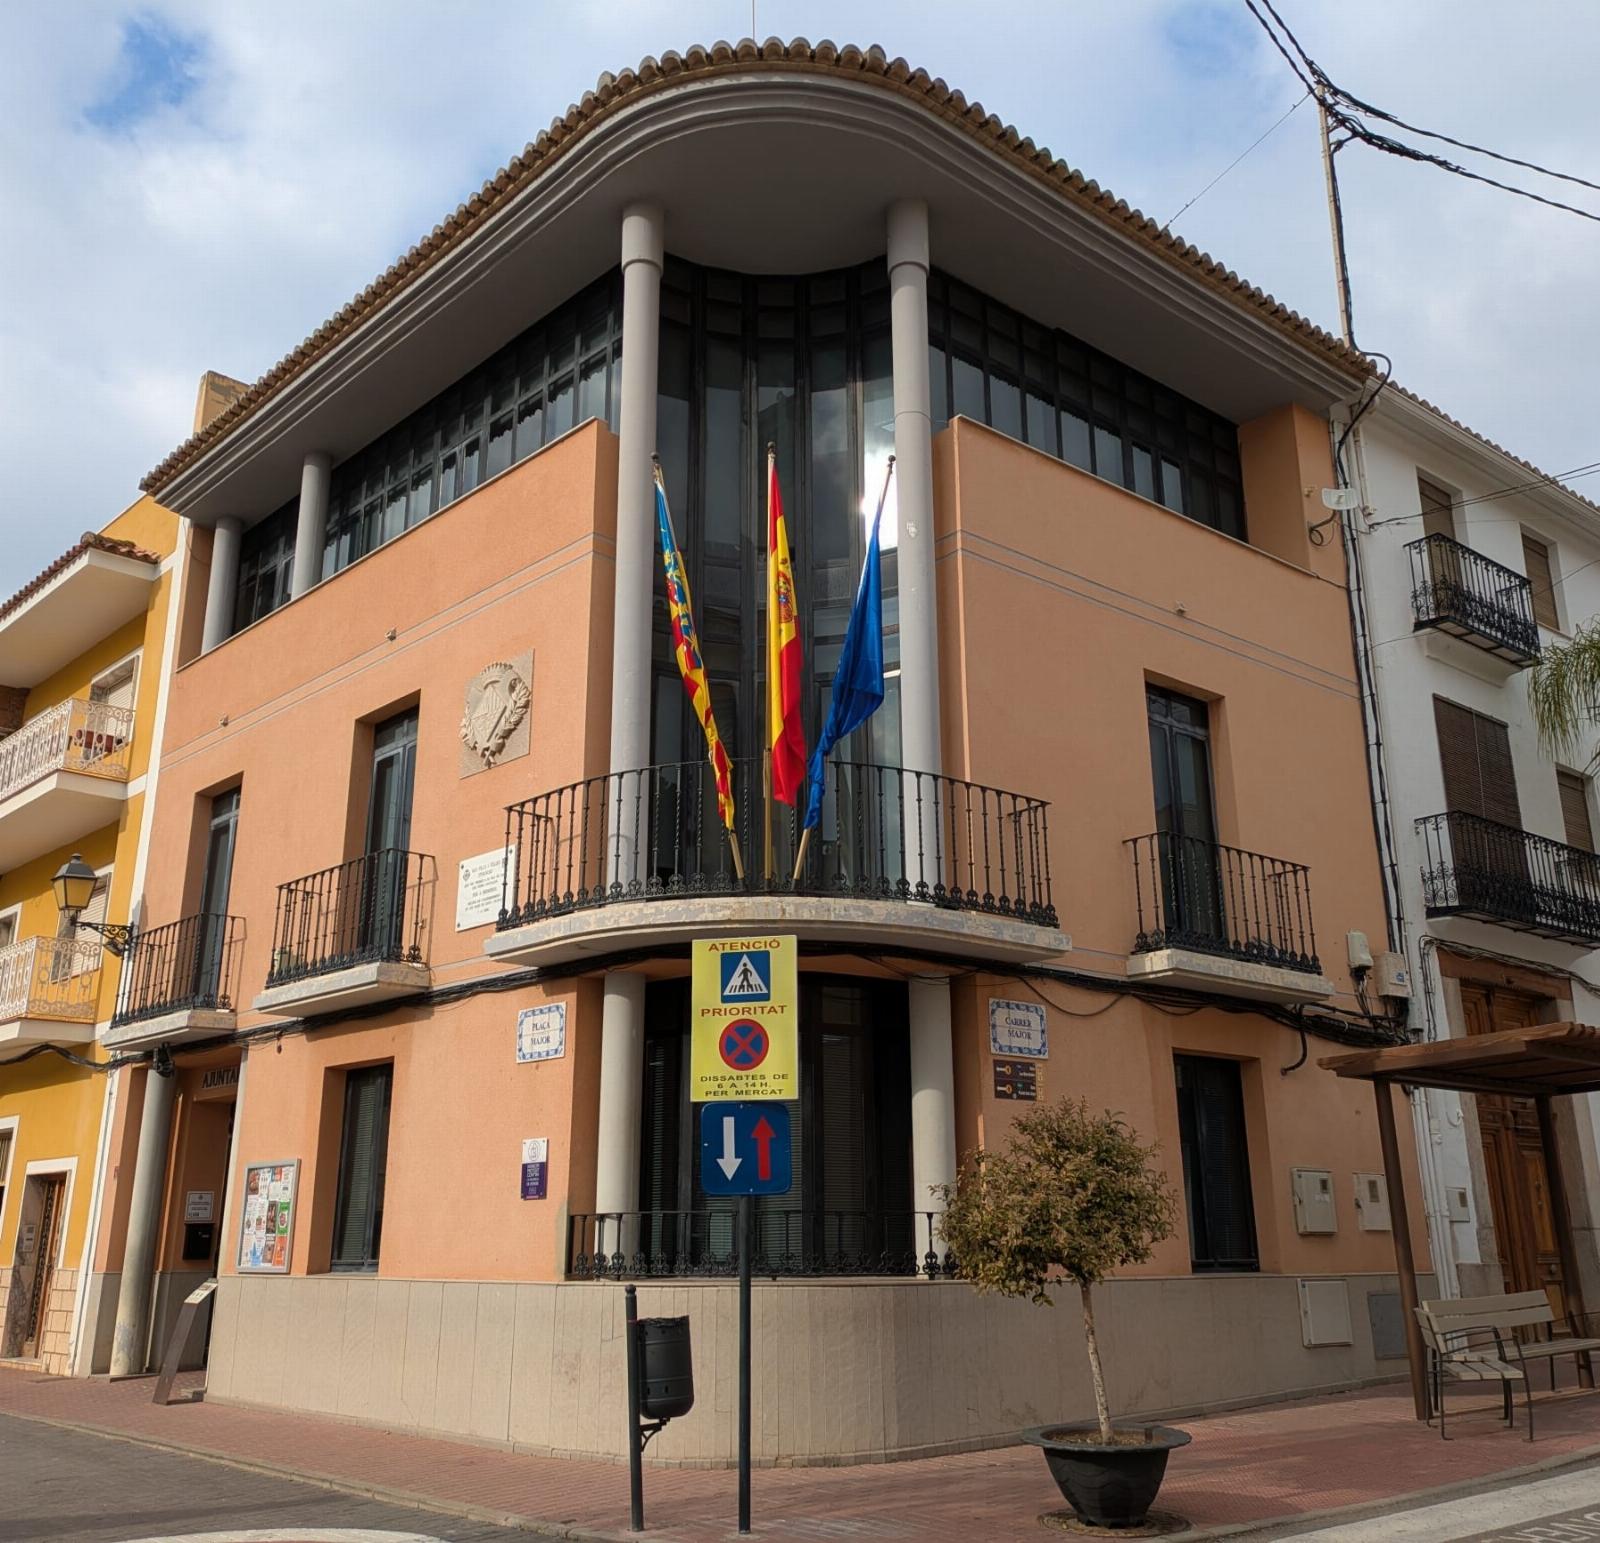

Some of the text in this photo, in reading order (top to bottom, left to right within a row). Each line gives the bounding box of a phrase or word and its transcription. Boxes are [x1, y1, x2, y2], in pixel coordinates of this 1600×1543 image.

[708, 939, 781, 952] ATENCIÓ
[701, 1005, 787, 1017] PRIORITAT
[532, 1022, 550, 1031] PLAÇA
[1005, 1016, 1032, 1027] CARRER
[531, 1035, 550, 1045] MAJOR
[1007, 1029, 1032, 1040] MAJOR
[202, 1067, 240, 1088] AJUNTA
[700, 1074, 766, 1082] DISSABTES
